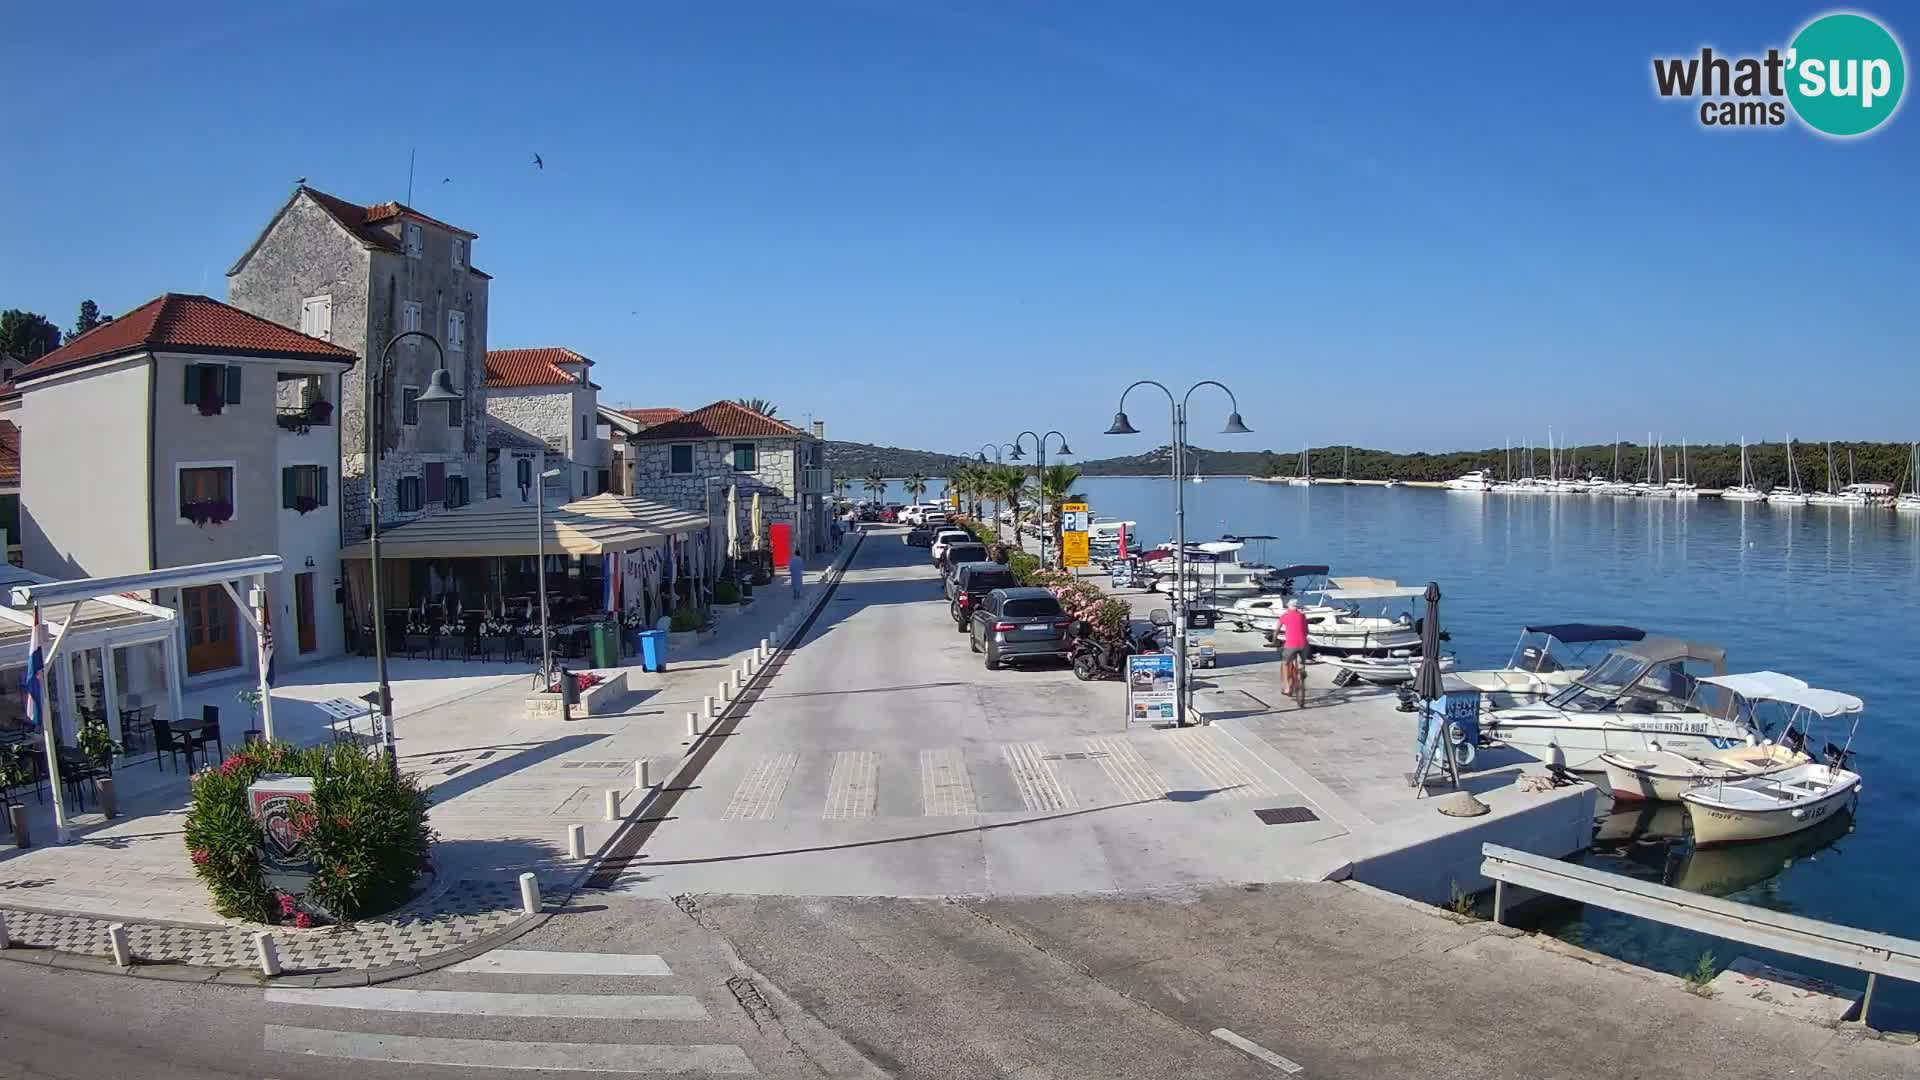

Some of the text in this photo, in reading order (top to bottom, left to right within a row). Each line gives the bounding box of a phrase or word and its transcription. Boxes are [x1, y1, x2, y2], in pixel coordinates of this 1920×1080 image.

[1665, 723, 1683, 733] RENT
[1684, 723, 1689, 732] A
[1691, 723, 1708, 733] BOAT
